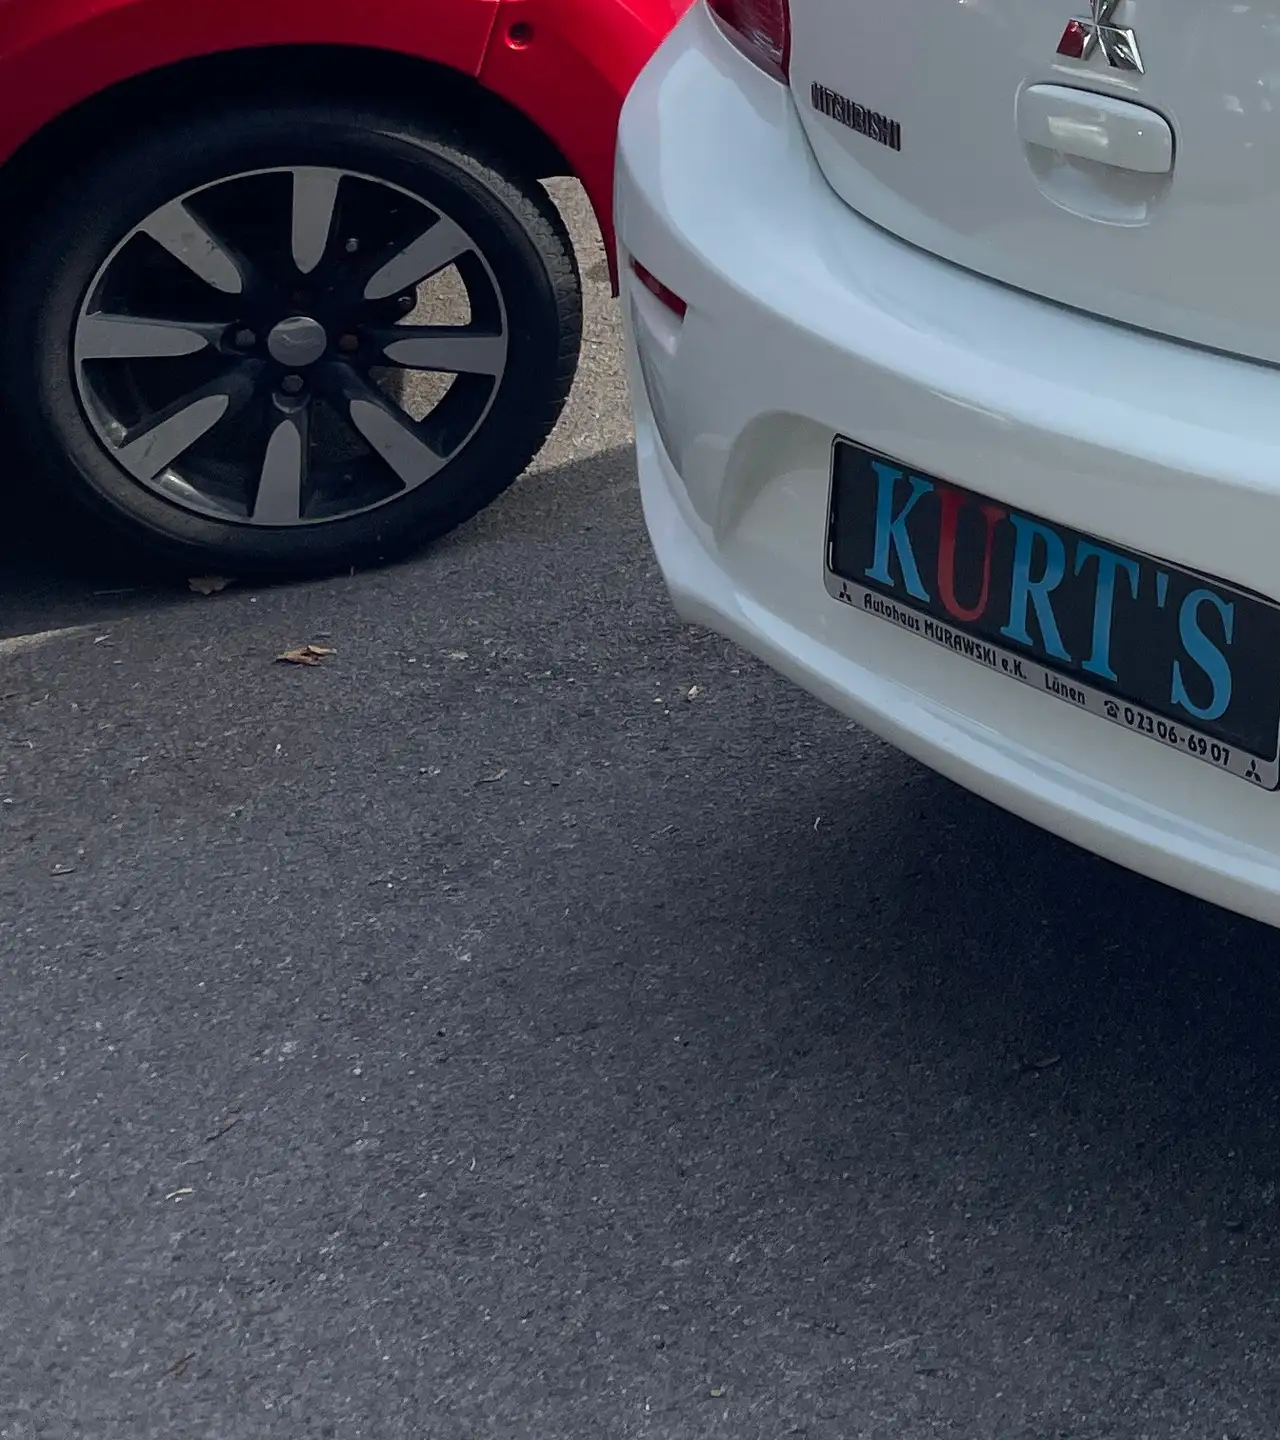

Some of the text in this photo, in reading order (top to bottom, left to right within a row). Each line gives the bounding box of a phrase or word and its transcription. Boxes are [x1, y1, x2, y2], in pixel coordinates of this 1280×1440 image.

[864, 593, 921, 631] Autohaus
[924, 619, 997, 667] MURAWSKI
[1045, 672, 1086, 705] Lünen
[865, 460, 1235, 721] KURT'S
